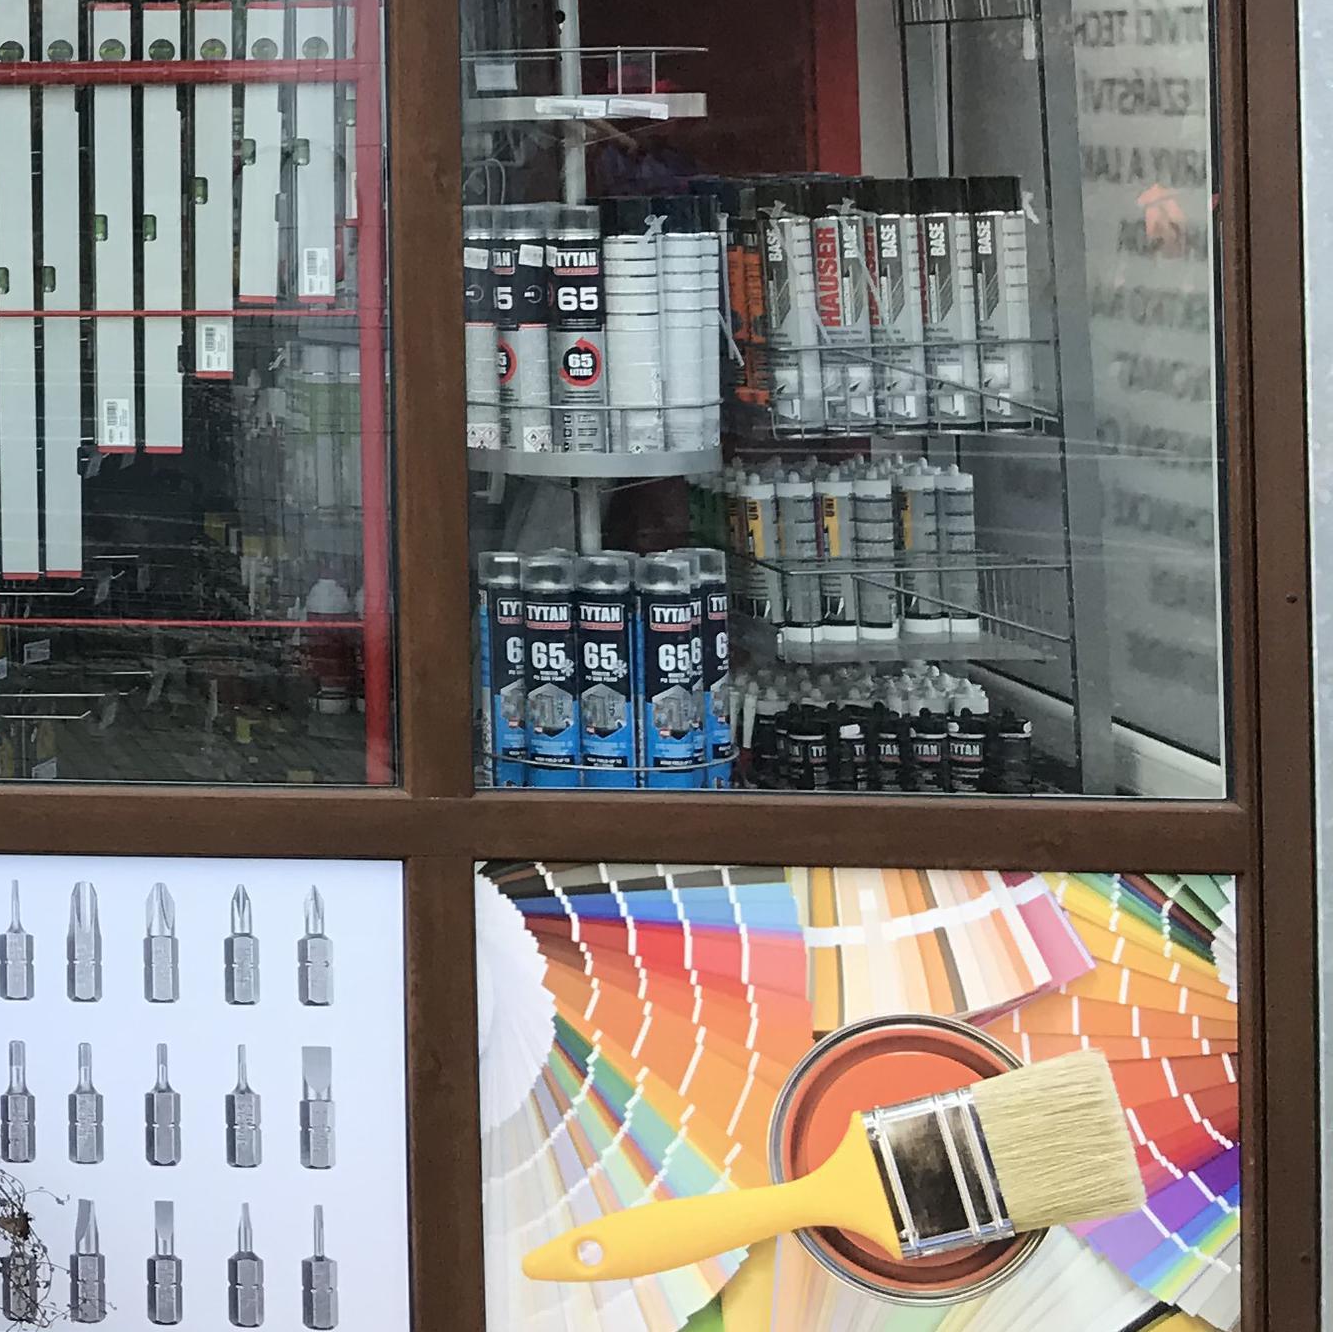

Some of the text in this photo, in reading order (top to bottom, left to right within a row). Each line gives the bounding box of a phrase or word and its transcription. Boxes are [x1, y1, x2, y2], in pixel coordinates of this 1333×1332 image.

[766, 227, 783, 263] BASE
[844, 223, 858, 259] BASE
[880, 222, 897, 258] BASE
[928, 221, 945, 257] BASE
[976, 220, 993, 255] BASE
[556, 250, 598, 267] TYTAN
[815, 226, 841, 328] HAUSER
[557, 286, 599, 311] 65
[568, 353, 593, 368] 65
[527, 604, 569, 622] TYTAN
[580, 605, 621, 622] TYTAN
[531, 641, 566, 670] 65
[583, 641, 618, 671] 65
[658, 643, 690, 672] 65
